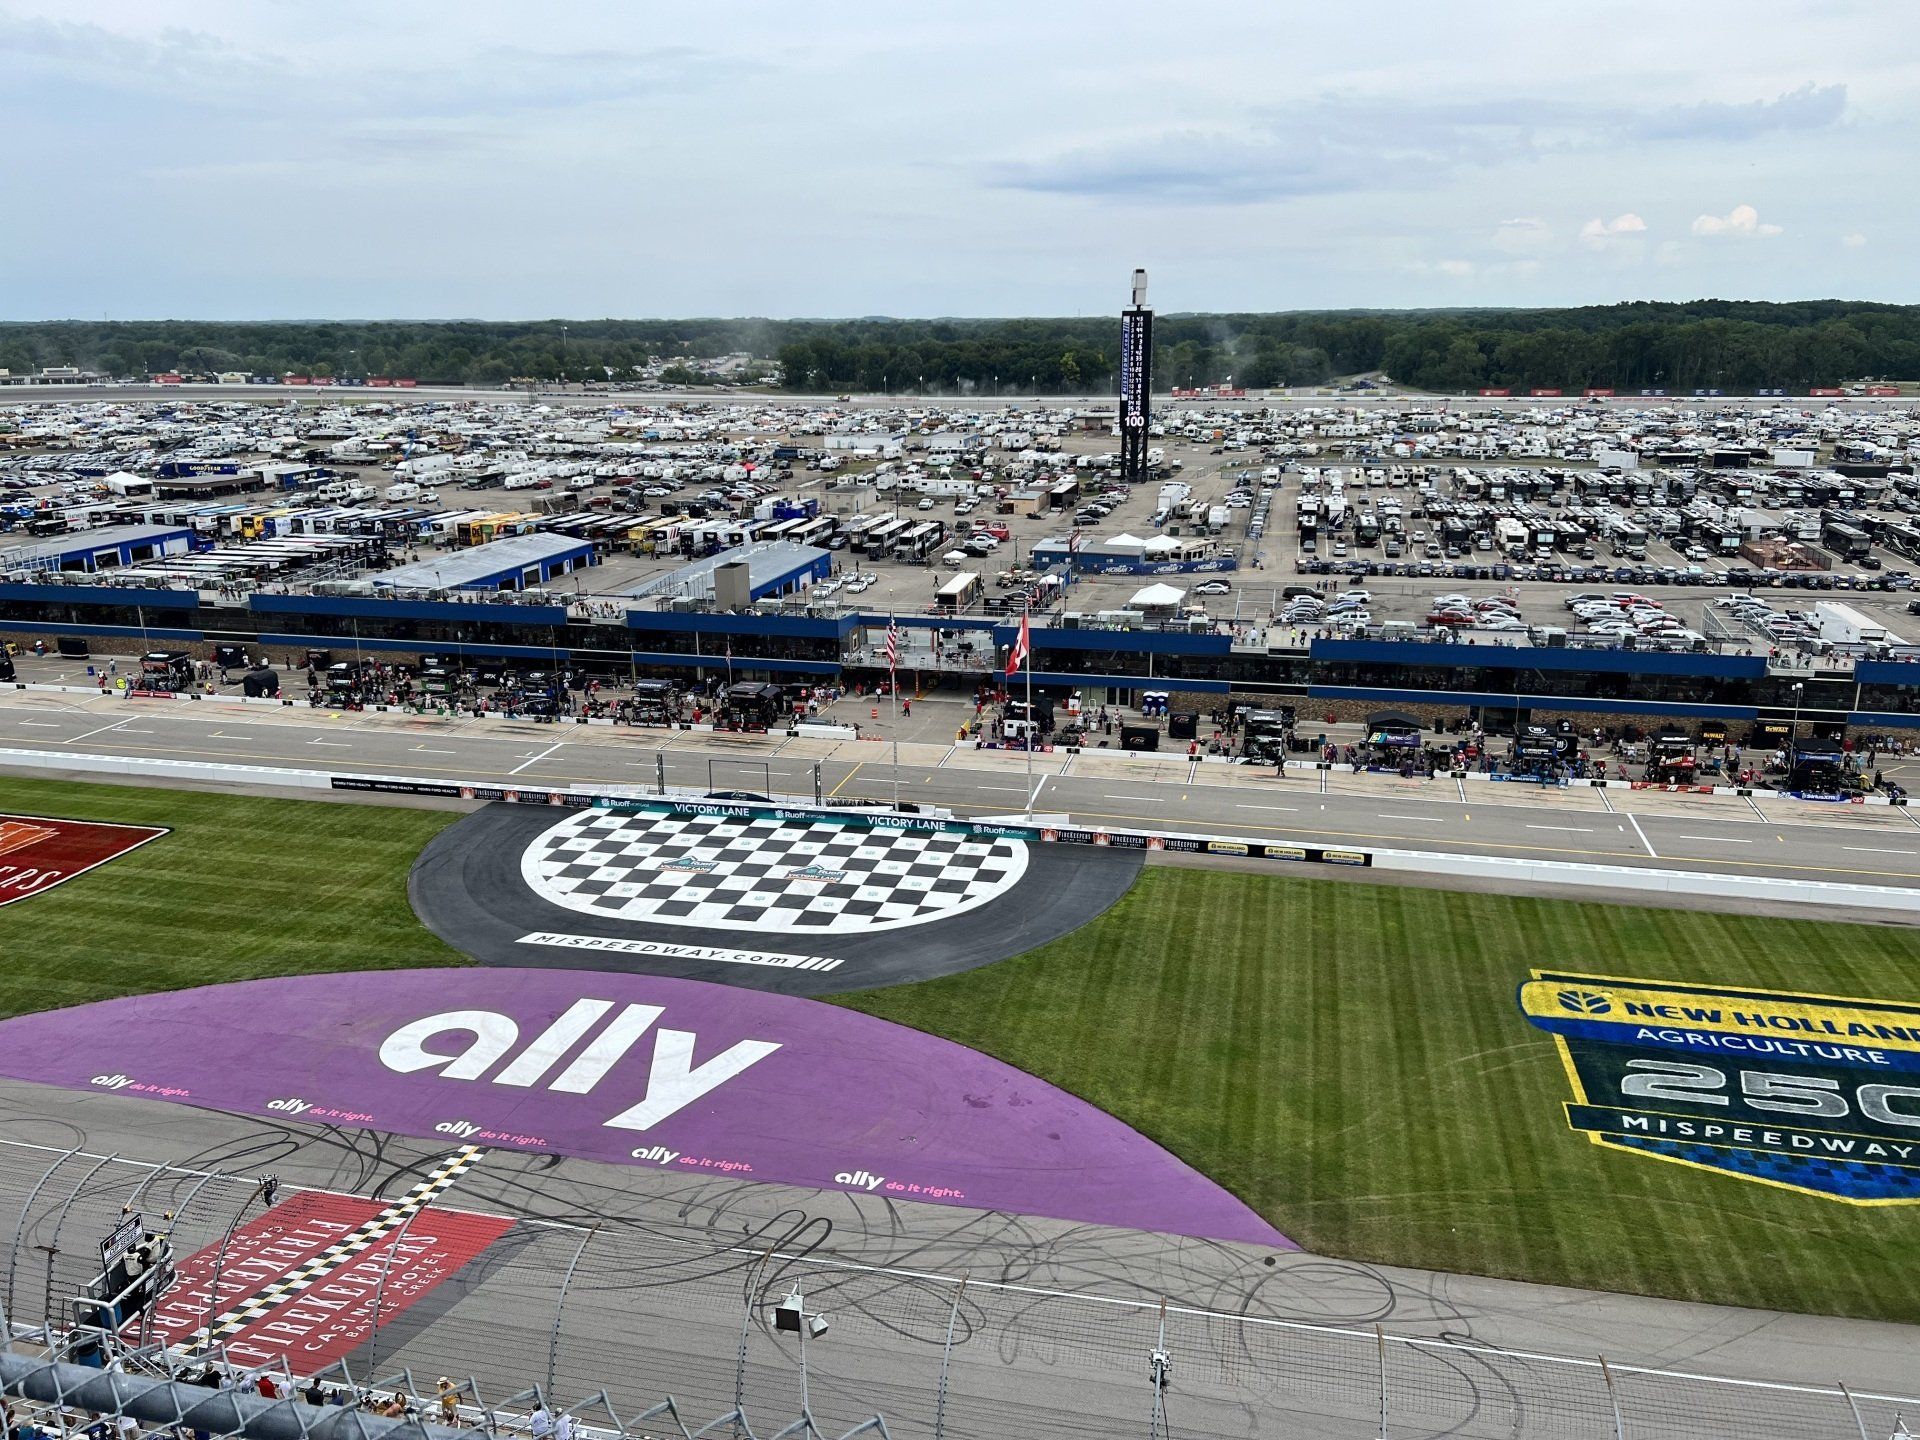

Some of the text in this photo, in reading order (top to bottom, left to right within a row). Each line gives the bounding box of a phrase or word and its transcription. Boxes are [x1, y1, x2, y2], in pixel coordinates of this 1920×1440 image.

[1125, 416, 1145, 427] 100
[610, 799, 631, 808] Ruoff
[675, 803, 750, 817] VICTORY LANE
[784, 810, 806, 819] Ruoff
[866, 815, 946, 830] VICTORY LANE
[983, 826, 1006, 835] Ruoff
[534, 934, 789, 965] MISPEEDWAY.com
[1627, 1001, 1722, 1023] NEW
[1636, 1028, 1890, 1065] AGRICULTURE
[378, 998, 783, 1131] ally
[91, 1074, 135, 1090] ally
[129, 1083, 190, 1096] do it right.
[266, 1098, 314, 1115] ally
[309, 1107, 374, 1122] do it right.
[435, 1120, 481, 1138] ally
[1622, 1115, 1913, 1159] MISPEEDWAY
[478, 1130, 548, 1146] do it right.
[631, 1146, 681, 1164] ally
[679, 1156, 753, 1173] do it right.
[834, 1170, 886, 1190] ally
[886, 1181, 965, 1199] do it right.
[402, 1267, 446, 1296] CREEK
[225, 1233, 438, 1359] FIREKEEPERS
[304, 1252, 448, 1351] CASINO HOTEL
